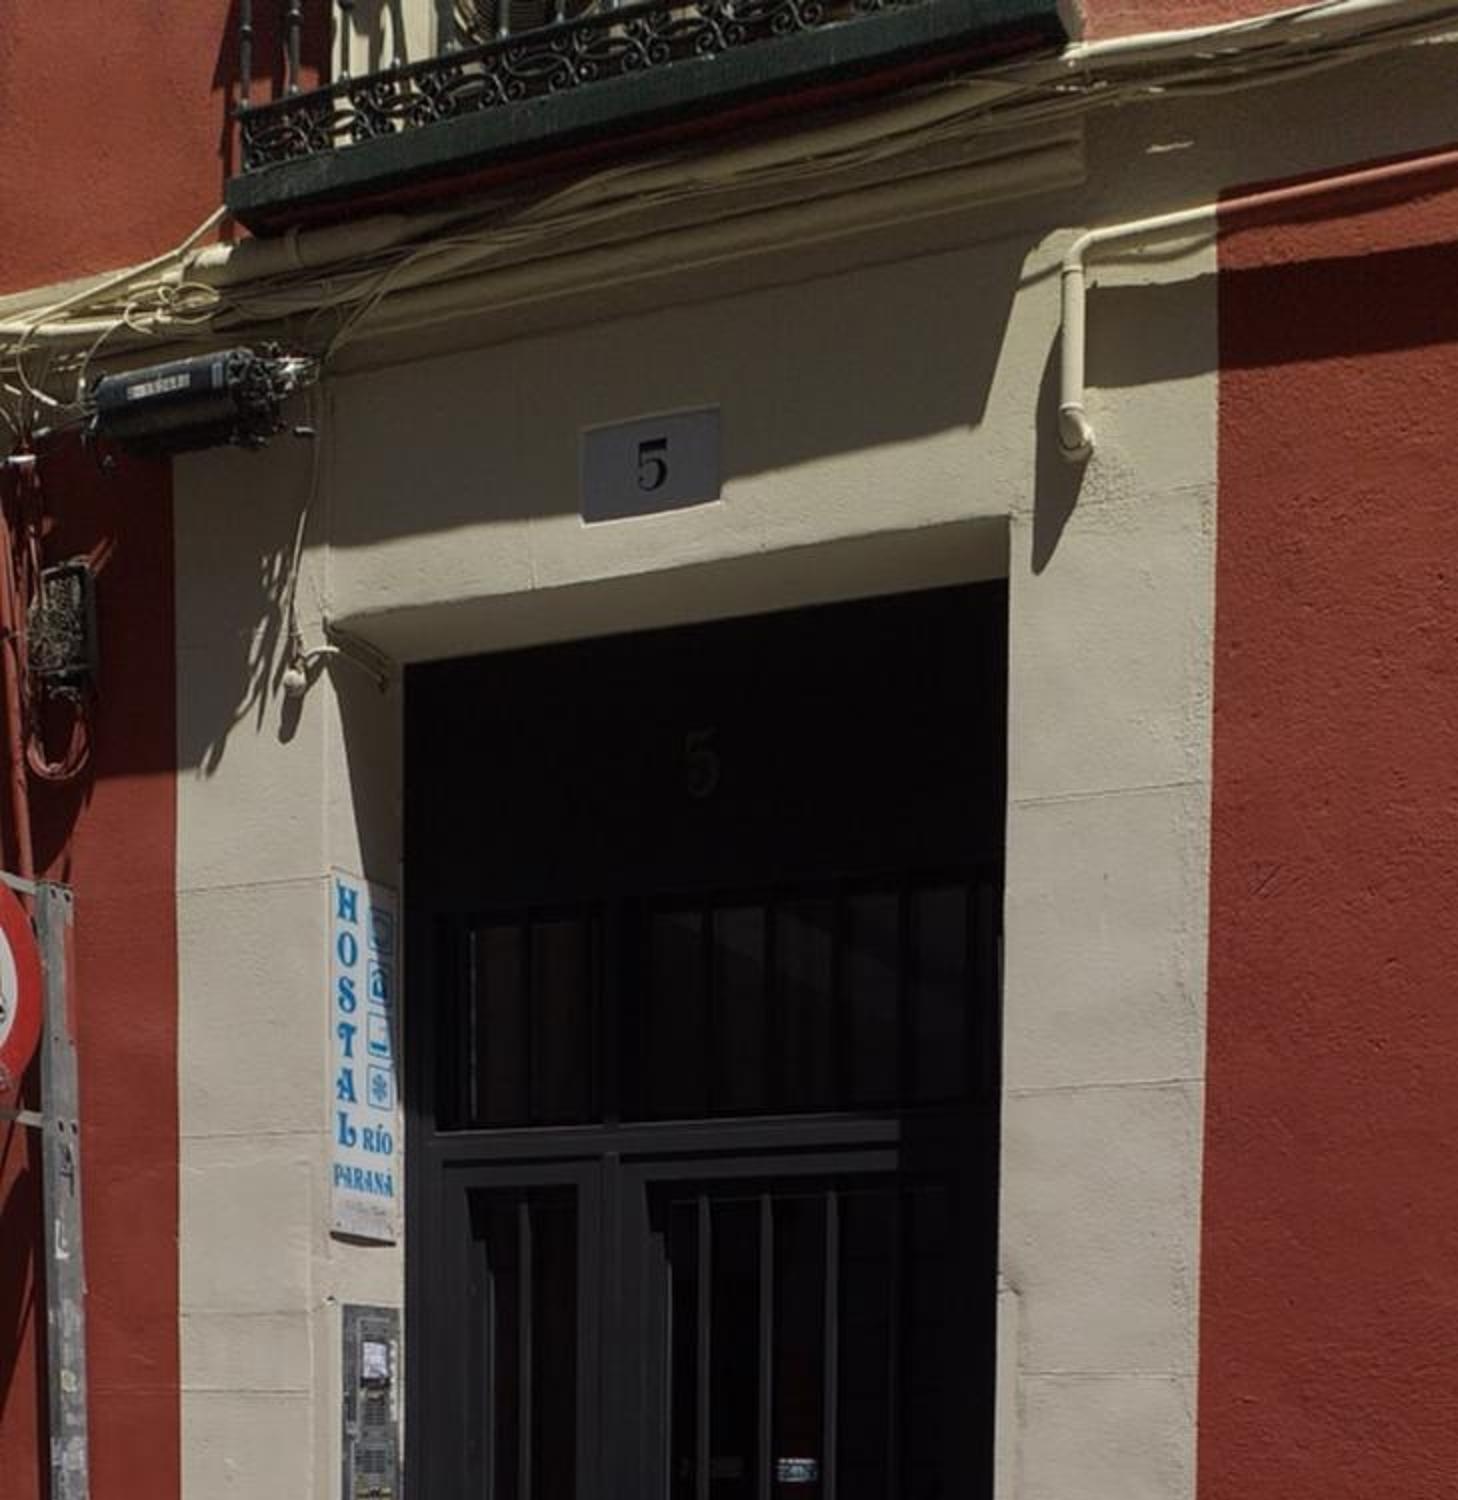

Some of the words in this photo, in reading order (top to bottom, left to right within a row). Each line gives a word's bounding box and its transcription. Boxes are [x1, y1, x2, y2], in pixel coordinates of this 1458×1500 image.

[638, 437, 668, 491] 5
[685, 725, 721, 798] 5
[336, 880, 358, 1148] HOSTAL
[363, 1123, 393, 1155] RÍO
